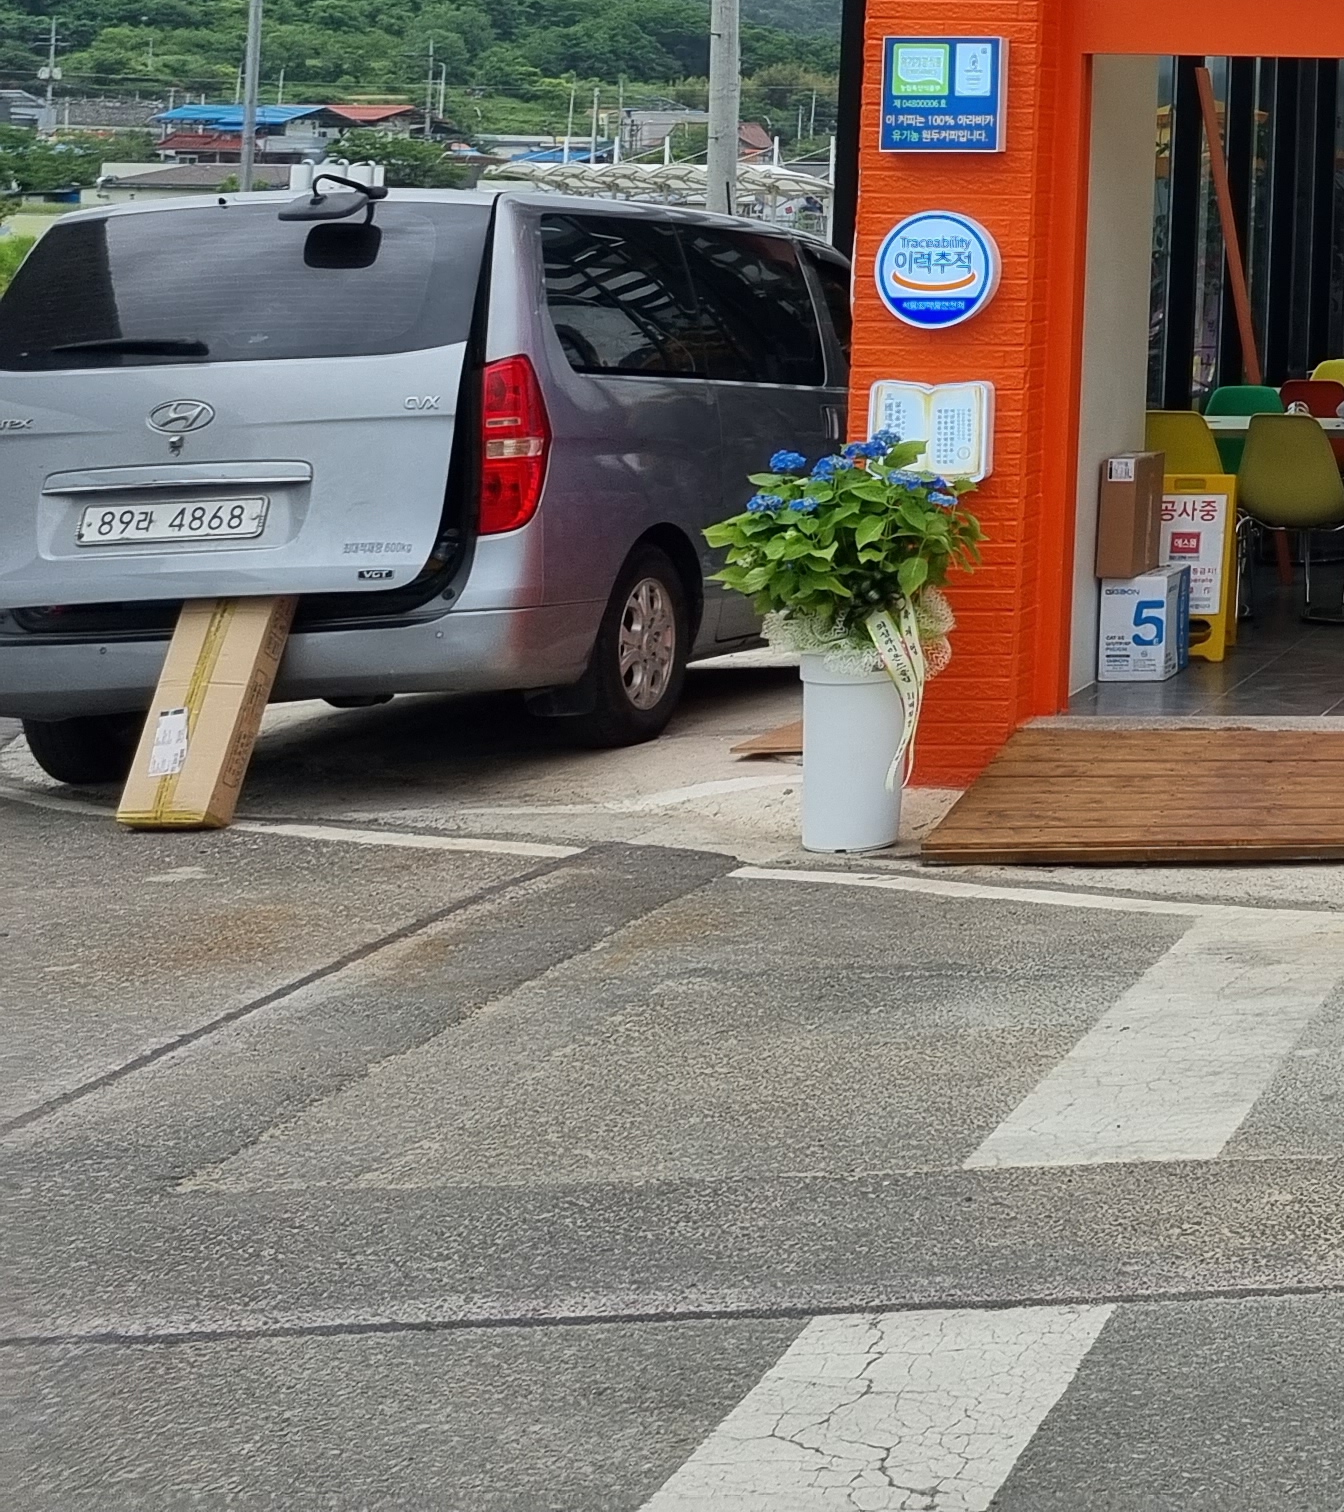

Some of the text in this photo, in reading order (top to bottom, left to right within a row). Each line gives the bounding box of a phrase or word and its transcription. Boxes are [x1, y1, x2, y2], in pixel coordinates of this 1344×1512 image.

[897, 114, 925, 126] 커피는
[928, 115, 955, 126] 100%
[891, 129, 919, 142] 유기농
[900, 235, 973, 251] Traceability
[894, 250, 973, 275] 이력추적
[403, 395, 441, 410] CVX
[0, 418, 33, 430] rex
[1160, 499, 1218, 522] 공사중
[96, 502, 246, 536] 89라 4868
[1174, 537, 1197, 549] 에스원
[363, 569, 390, 580] VGT
[1132, 600, 1165, 646] 5
